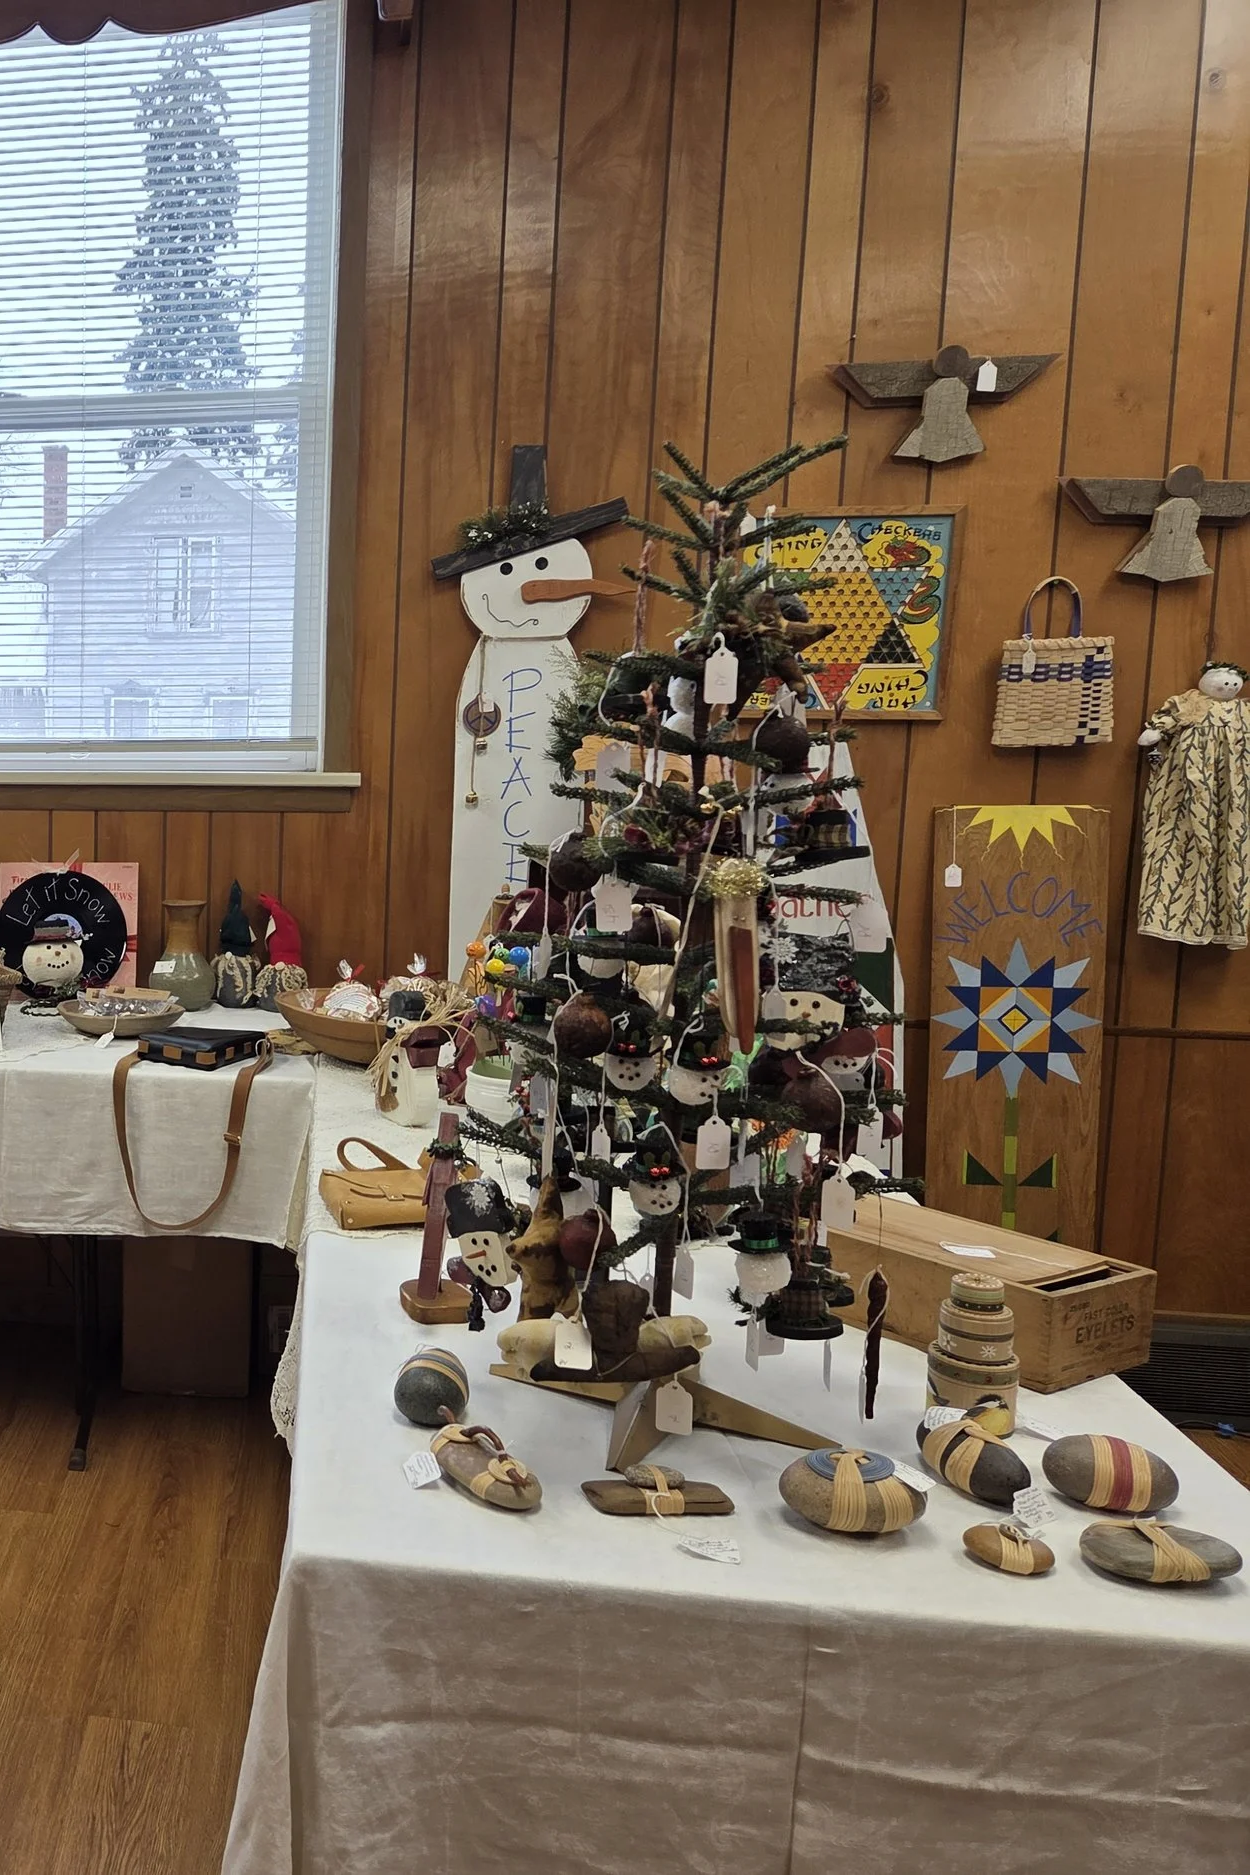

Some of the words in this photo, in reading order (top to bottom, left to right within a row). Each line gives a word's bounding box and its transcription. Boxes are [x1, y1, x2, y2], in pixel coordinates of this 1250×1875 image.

[857, 522, 942, 543] CHECKERS
[501, 668, 542, 883] PEACE
[6, 886, 41, 926] Let
[44, 878, 60, 902] it
[64, 877, 111, 924] Snow
[935, 871, 1104, 947] WELCOME
[1075, 1314, 1135, 1344] EYELETS
